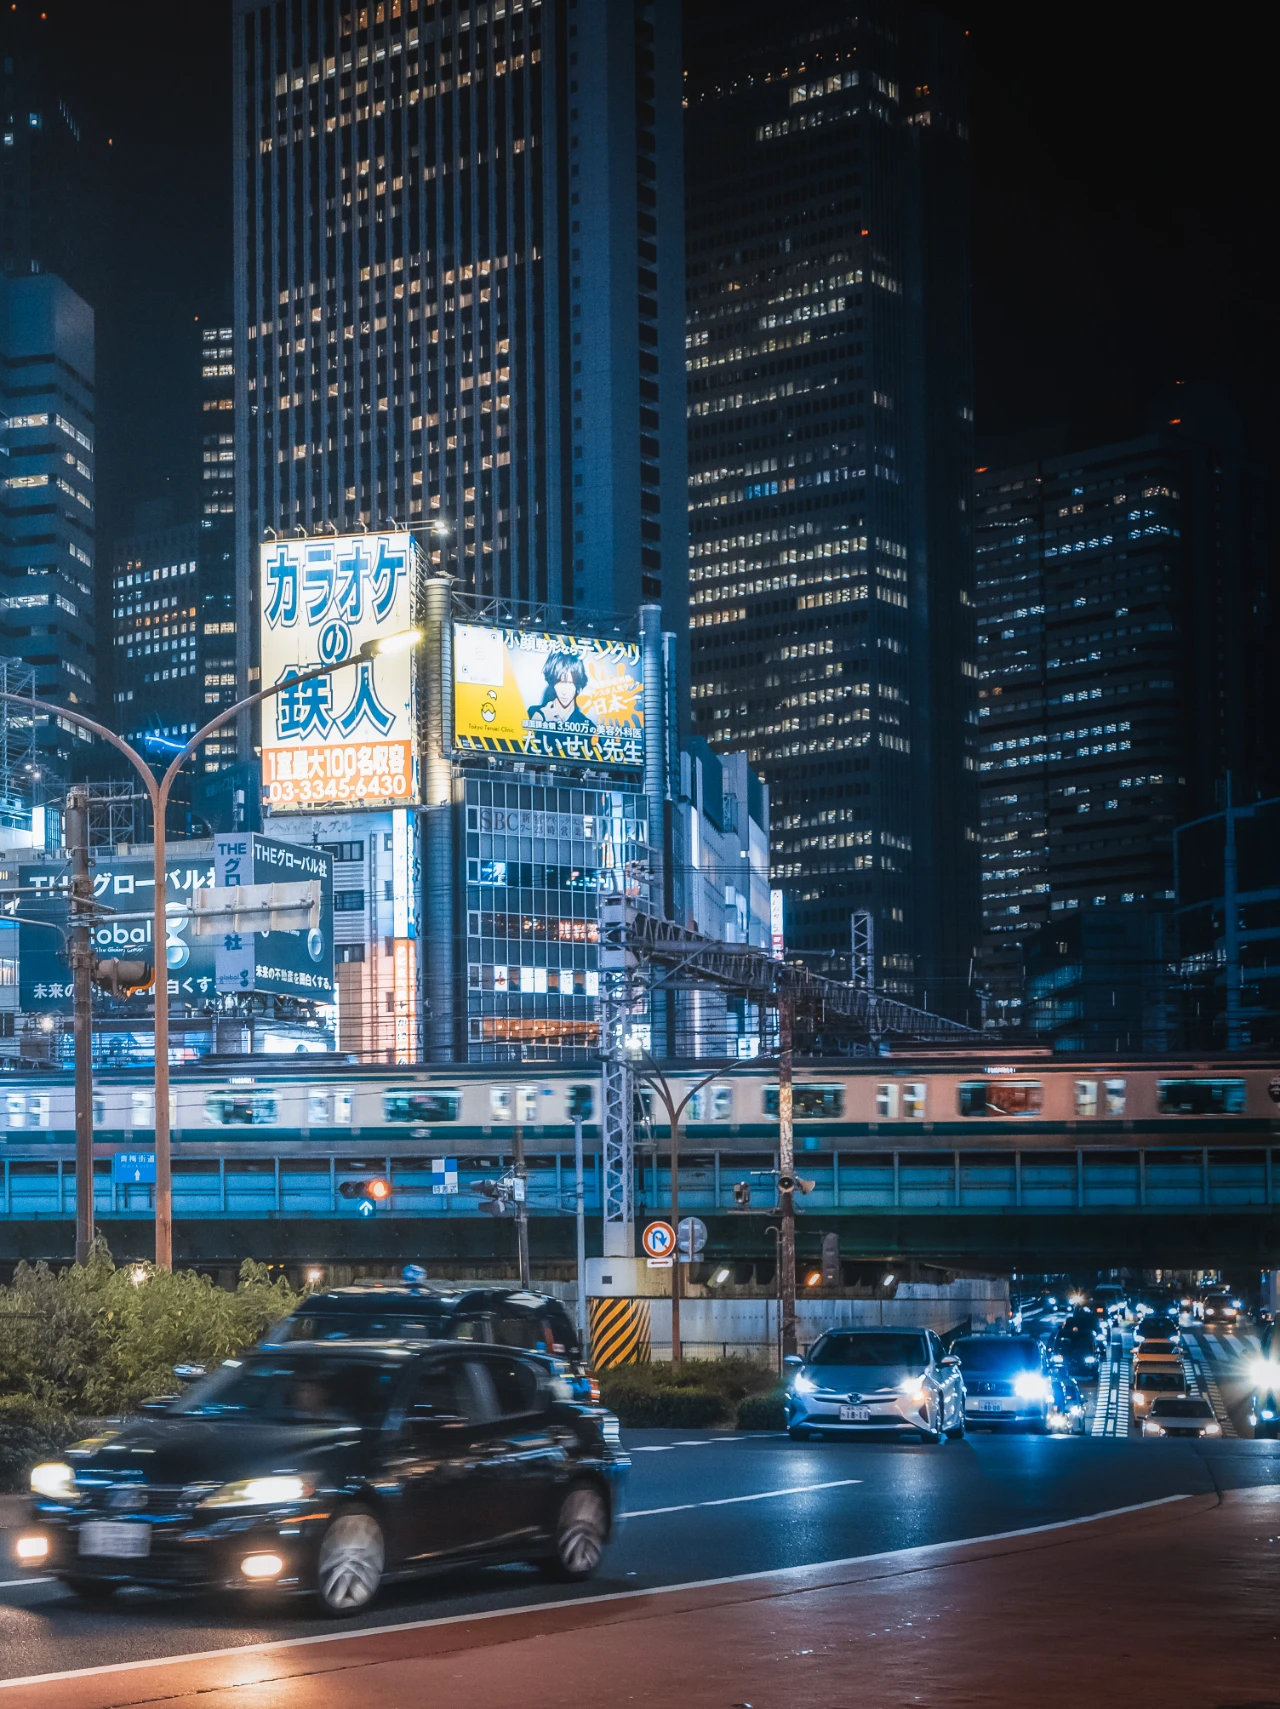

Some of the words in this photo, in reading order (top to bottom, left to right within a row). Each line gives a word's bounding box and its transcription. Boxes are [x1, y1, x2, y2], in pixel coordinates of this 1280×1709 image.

[264, 537, 408, 630] カラオケ
[318, 618, 353, 665] の
[275, 660, 397, 741] 鉄人
[268, 744, 406, 781] 1室最大100名収容
[522, 731, 644, 763] たいせい先生
[270, 774, 407, 801] 03-3345-6430
[480, 810, 519, 831] SBC
[255, 843, 328, 878] THEグローバル社
[29, 867, 215, 897] THグローバル
[91, 920, 151, 945] lobal
